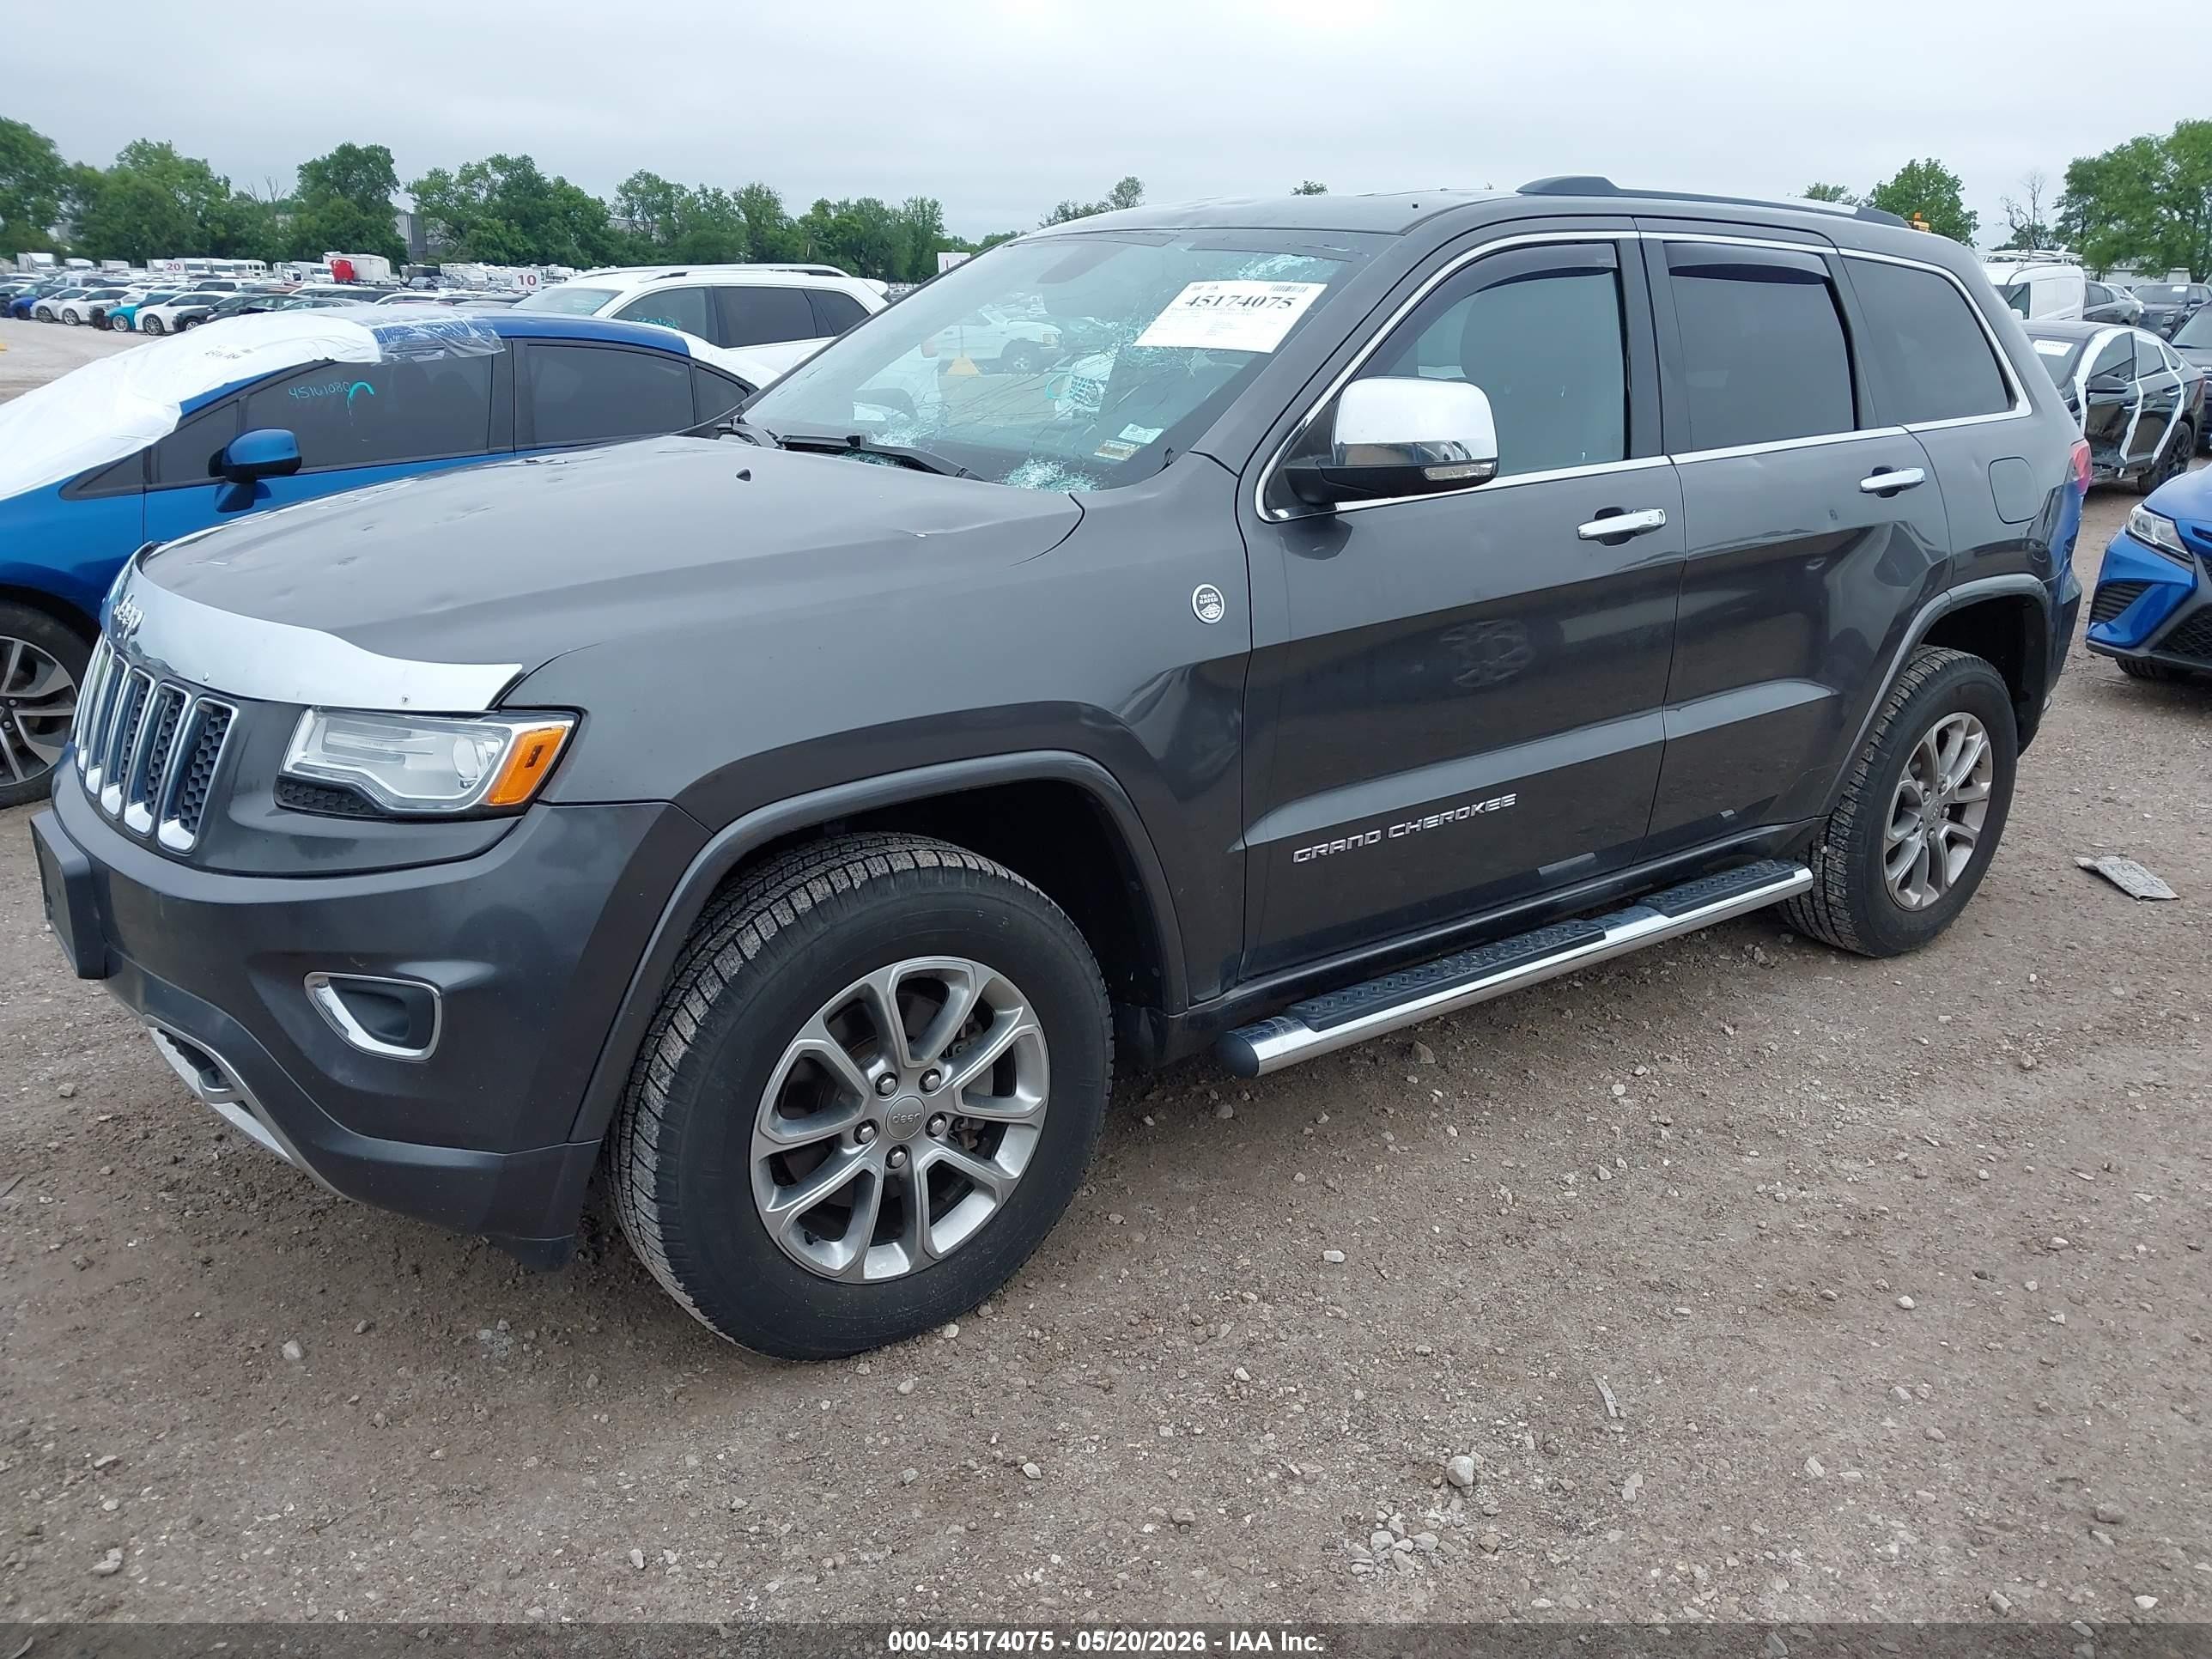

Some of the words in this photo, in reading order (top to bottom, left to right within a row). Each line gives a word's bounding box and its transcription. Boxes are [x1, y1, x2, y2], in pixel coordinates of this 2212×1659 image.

[166, 263, 181, 271] 20
[517, 274, 537, 286] 10
[1185, 295, 1297, 309] 45174075
[1292, 830, 1382, 863] GRAND
[1388, 793, 1517, 839] CHEROKEE
